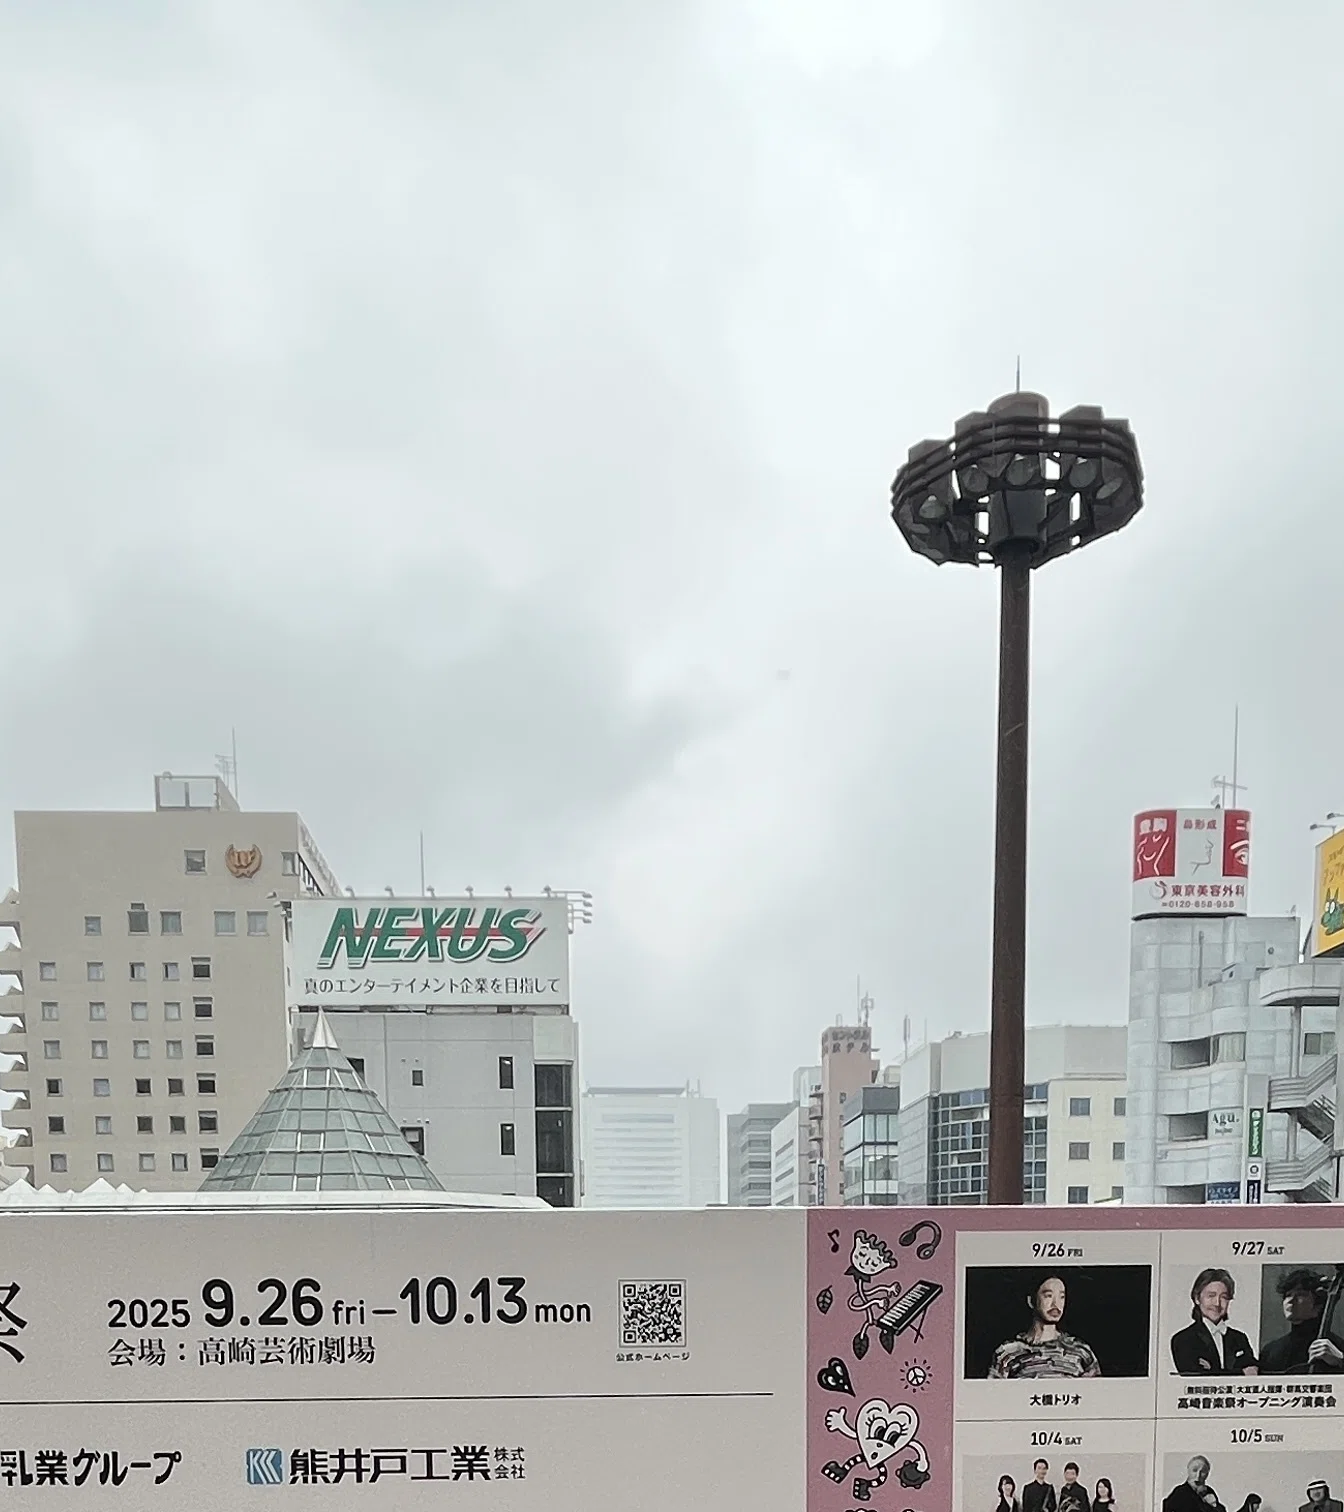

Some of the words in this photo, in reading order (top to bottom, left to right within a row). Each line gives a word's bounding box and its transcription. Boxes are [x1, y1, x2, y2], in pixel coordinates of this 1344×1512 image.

[1171, 884, 1246, 897] 東京美容外科
[317, 905, 548, 969] NEXUS
[303, 976, 560, 996] 真のエンターテイメント企業を目指して
[1032, 1243, 1065, 1258] 9/26
[1232, 1241, 1264, 1255] 9/27
[108, 1299, 190, 1328] 2025
[202, 1278, 323, 1327] 9.26
[535, 1304, 591, 1323] mon
[616, 1352, 689, 1361] 公式ホームページ
[1030, 1394, 1082, 1406] 大橋トリオ
[1031, 1431, 1062, 1445] 10/4
[1231, 1429, 1262, 1443] 10/5
[289, 1446, 491, 1485] 熊井戸工業
